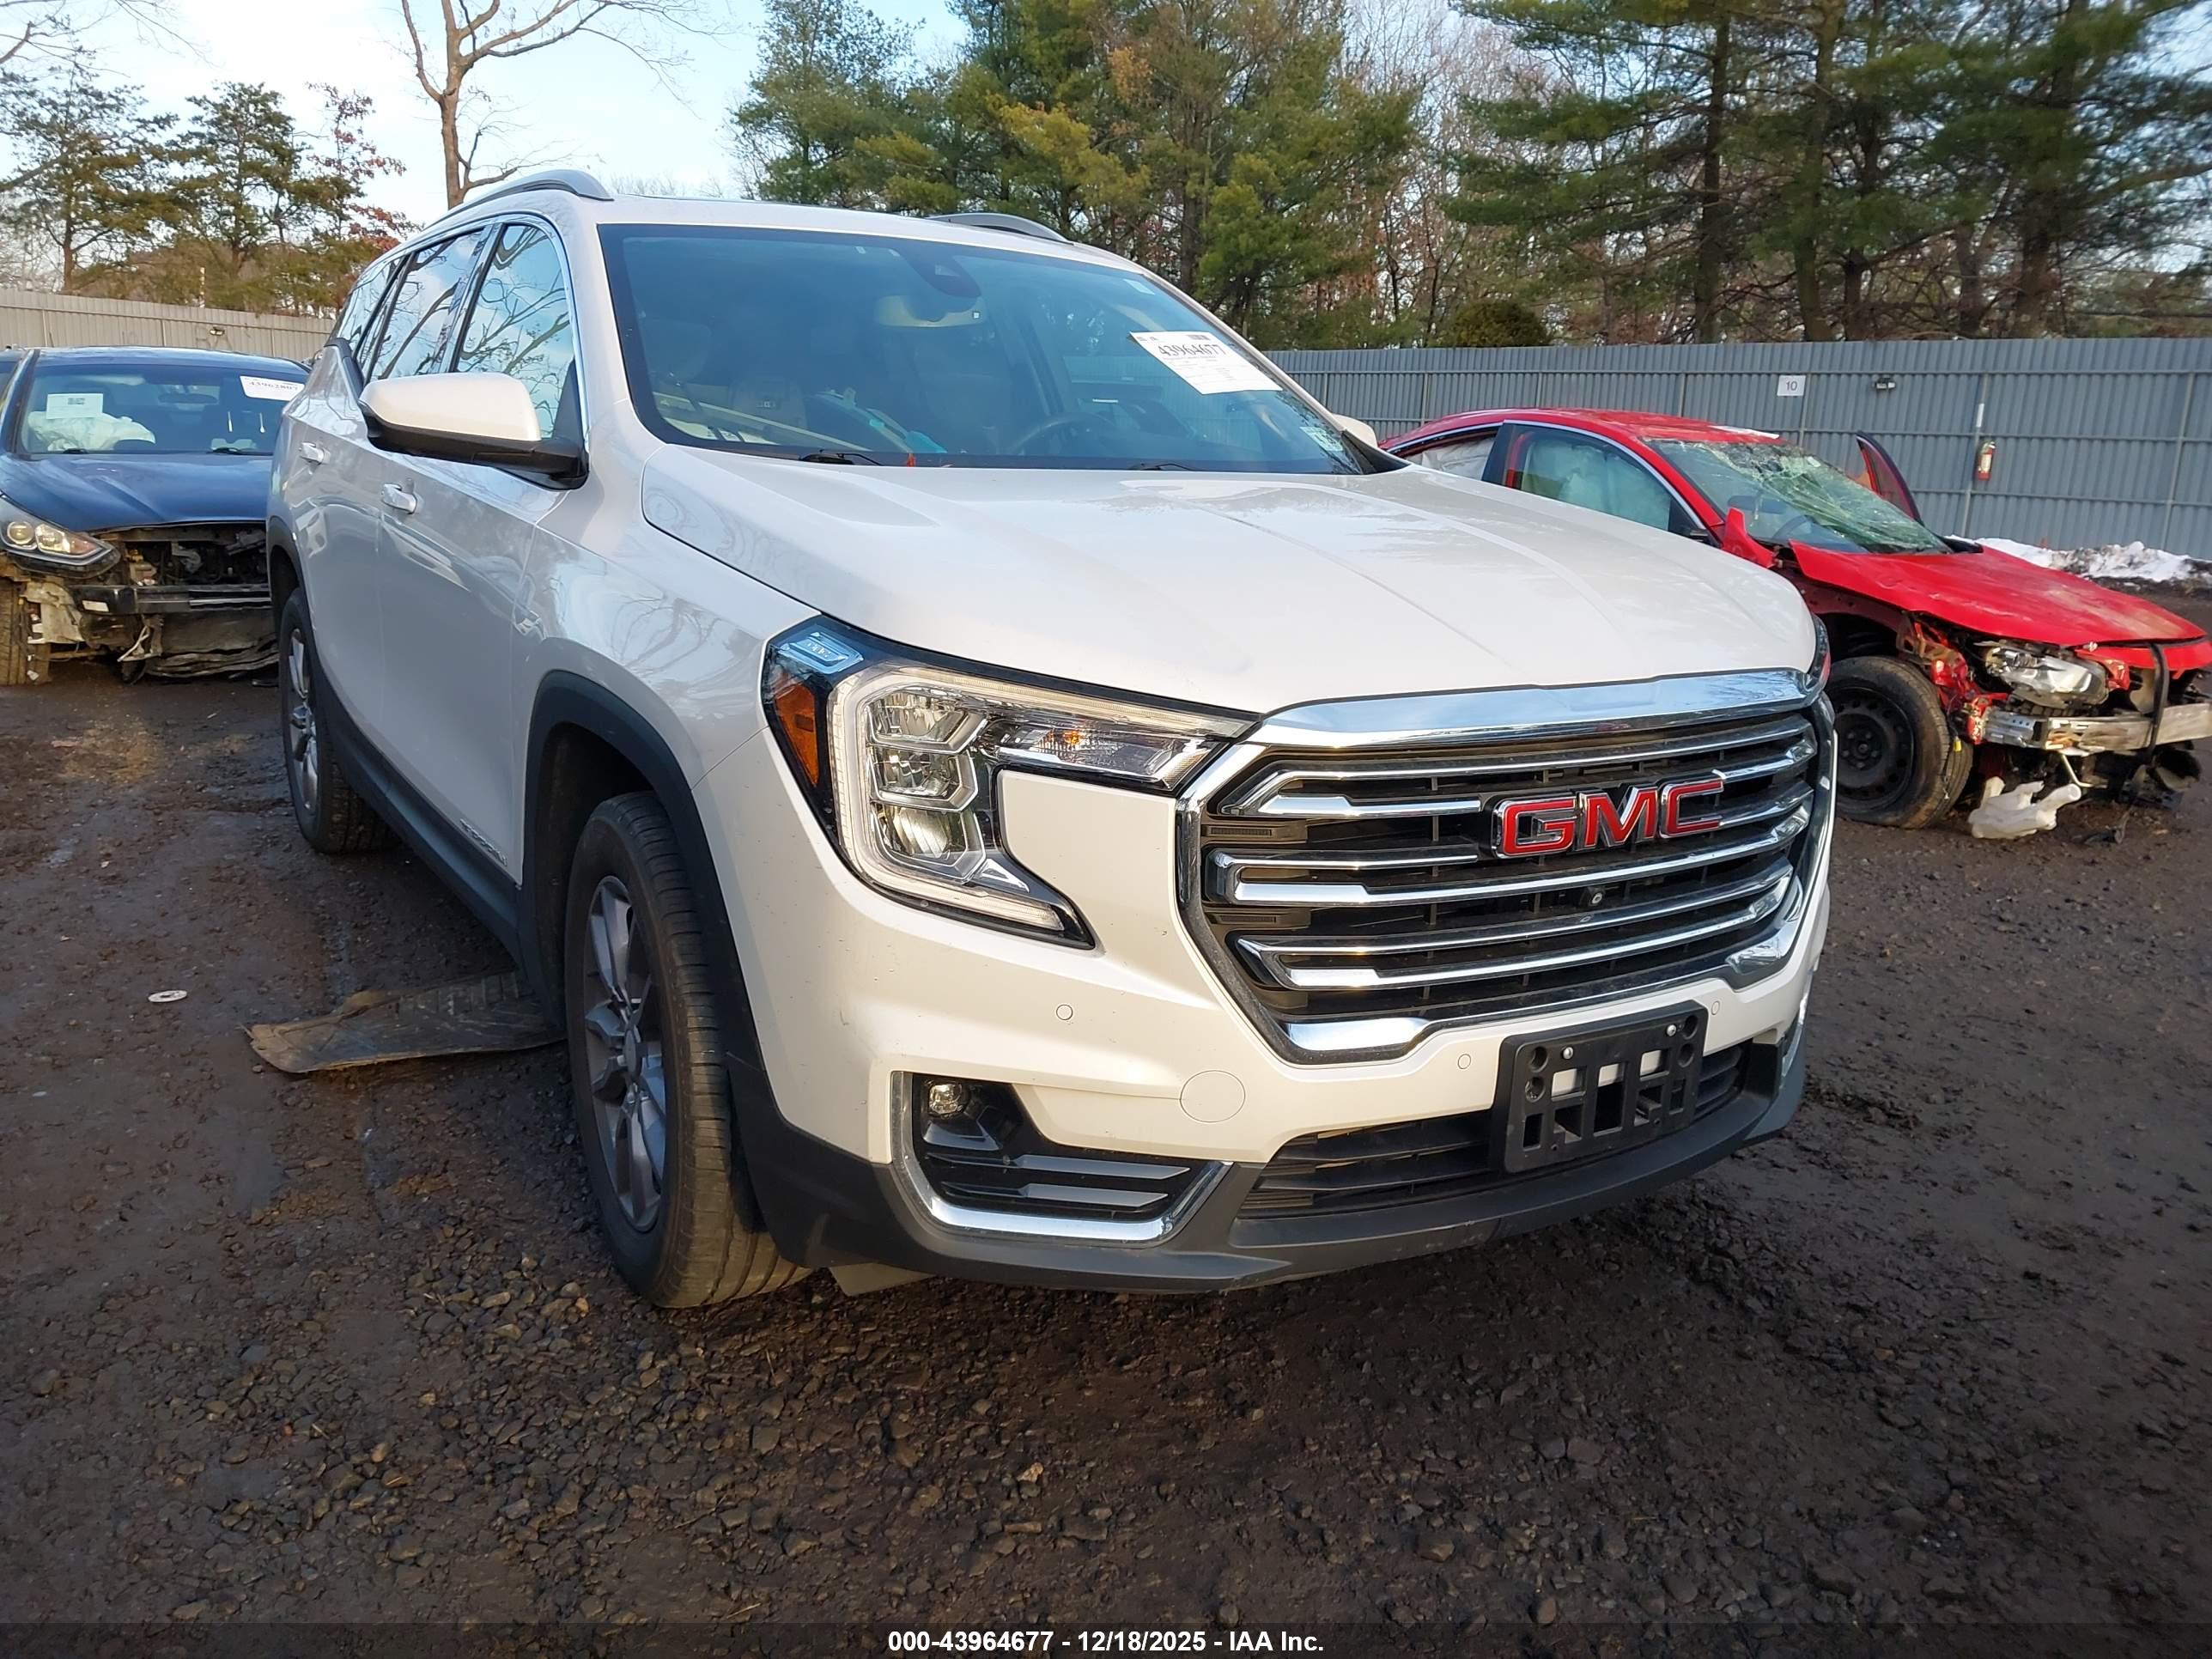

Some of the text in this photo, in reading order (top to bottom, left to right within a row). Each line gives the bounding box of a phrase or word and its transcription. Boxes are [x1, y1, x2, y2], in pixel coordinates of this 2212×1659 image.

[1158, 343, 1226, 356] 43964677
[1785, 380, 1798, 392] 10
[1494, 778, 1724, 858] GMC
